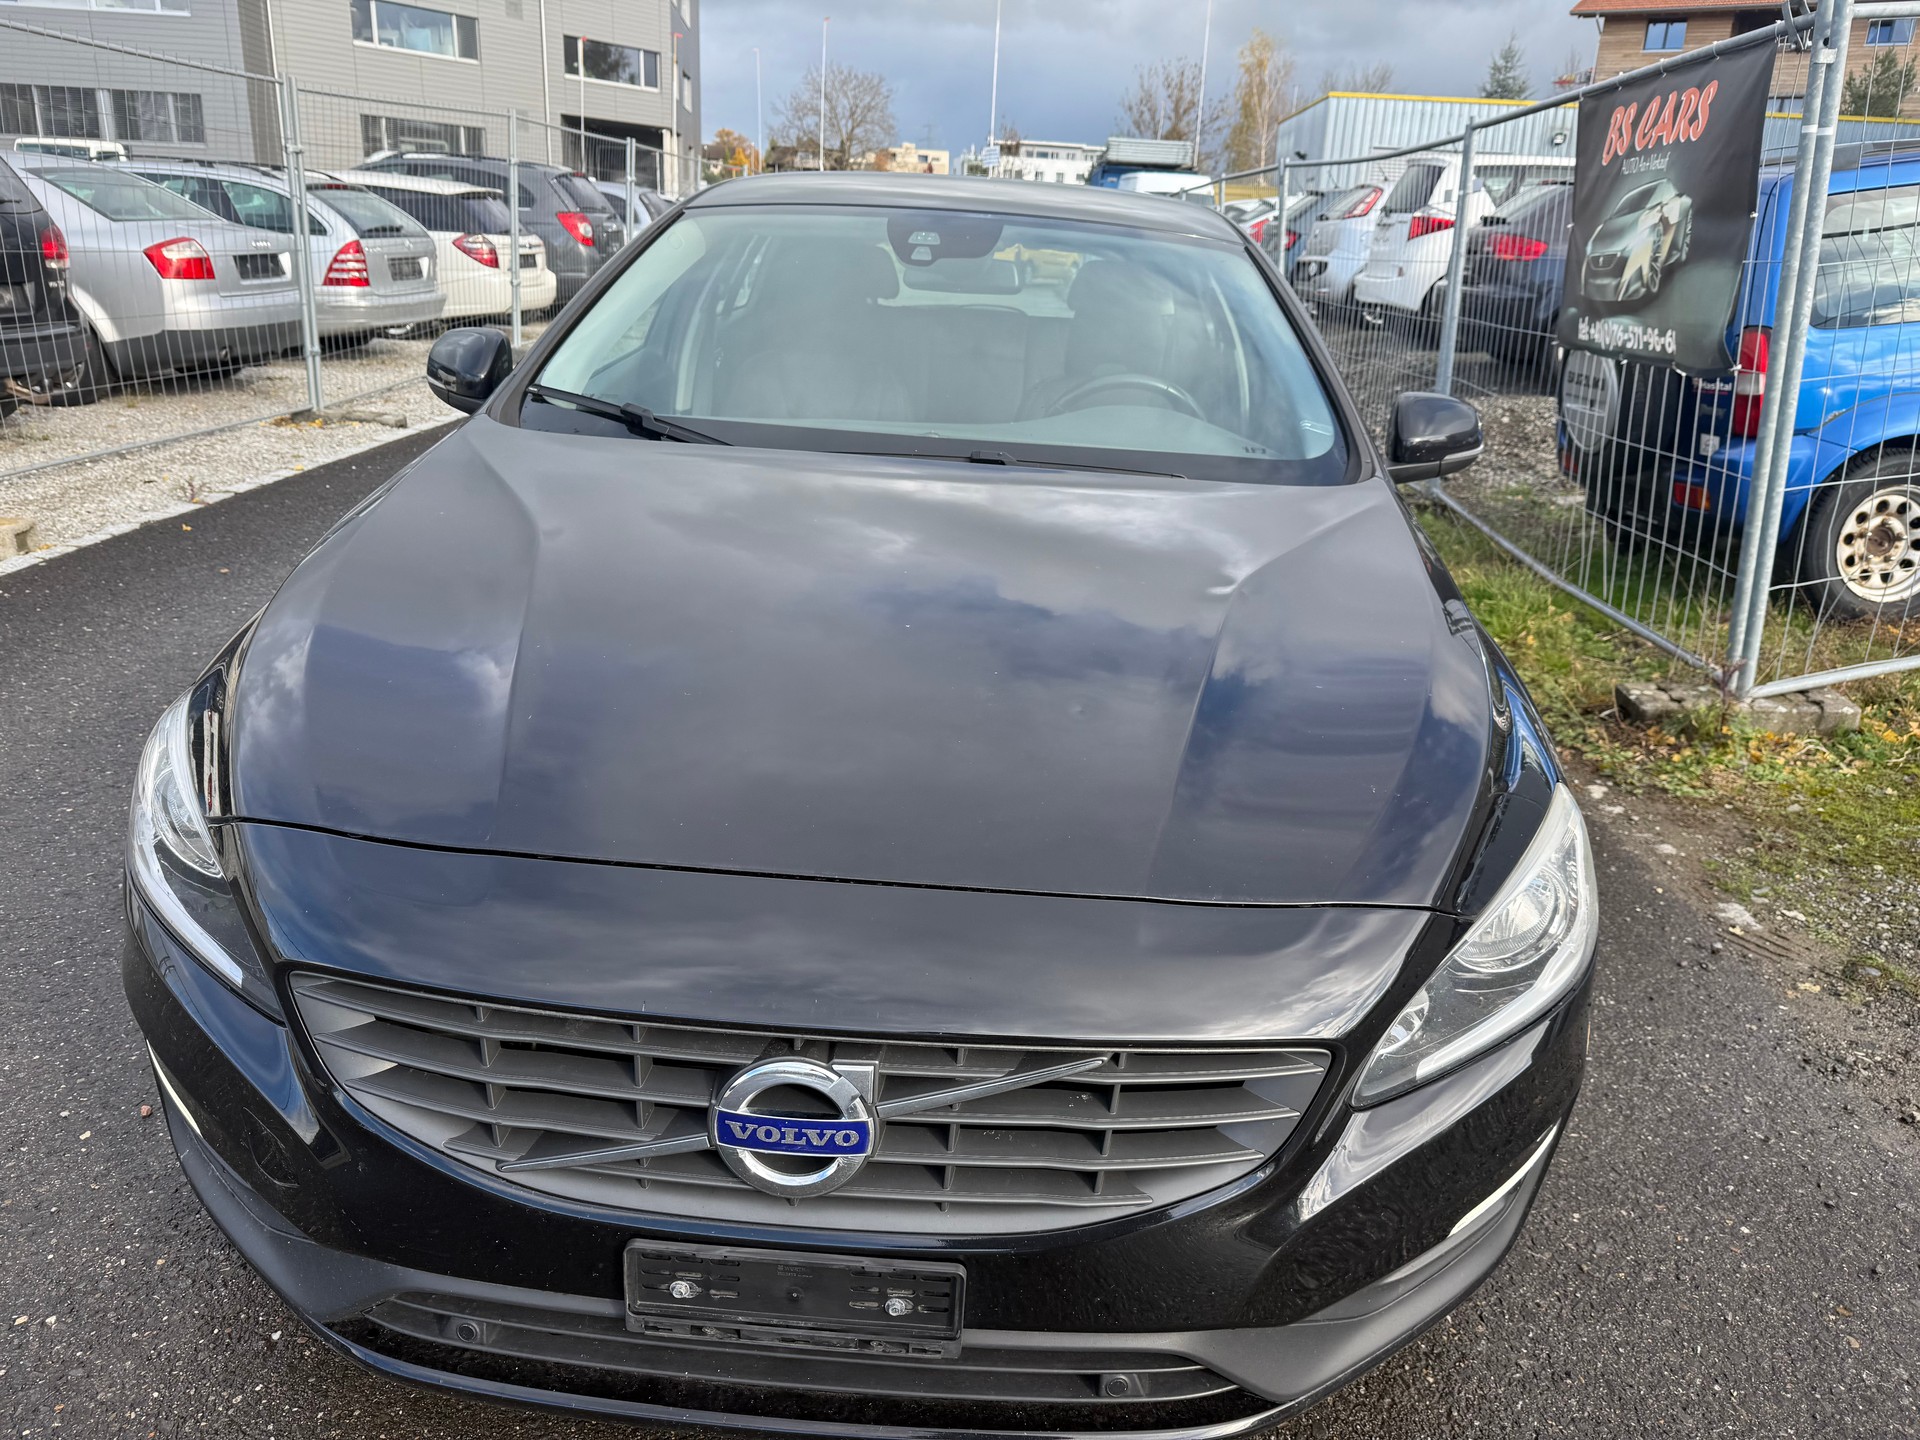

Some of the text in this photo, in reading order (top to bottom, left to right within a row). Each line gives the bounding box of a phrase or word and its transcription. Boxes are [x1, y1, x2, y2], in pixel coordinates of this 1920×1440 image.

[1602, 79, 1719, 166] BS CARS
[725, 1120, 860, 1147] VOLVO
